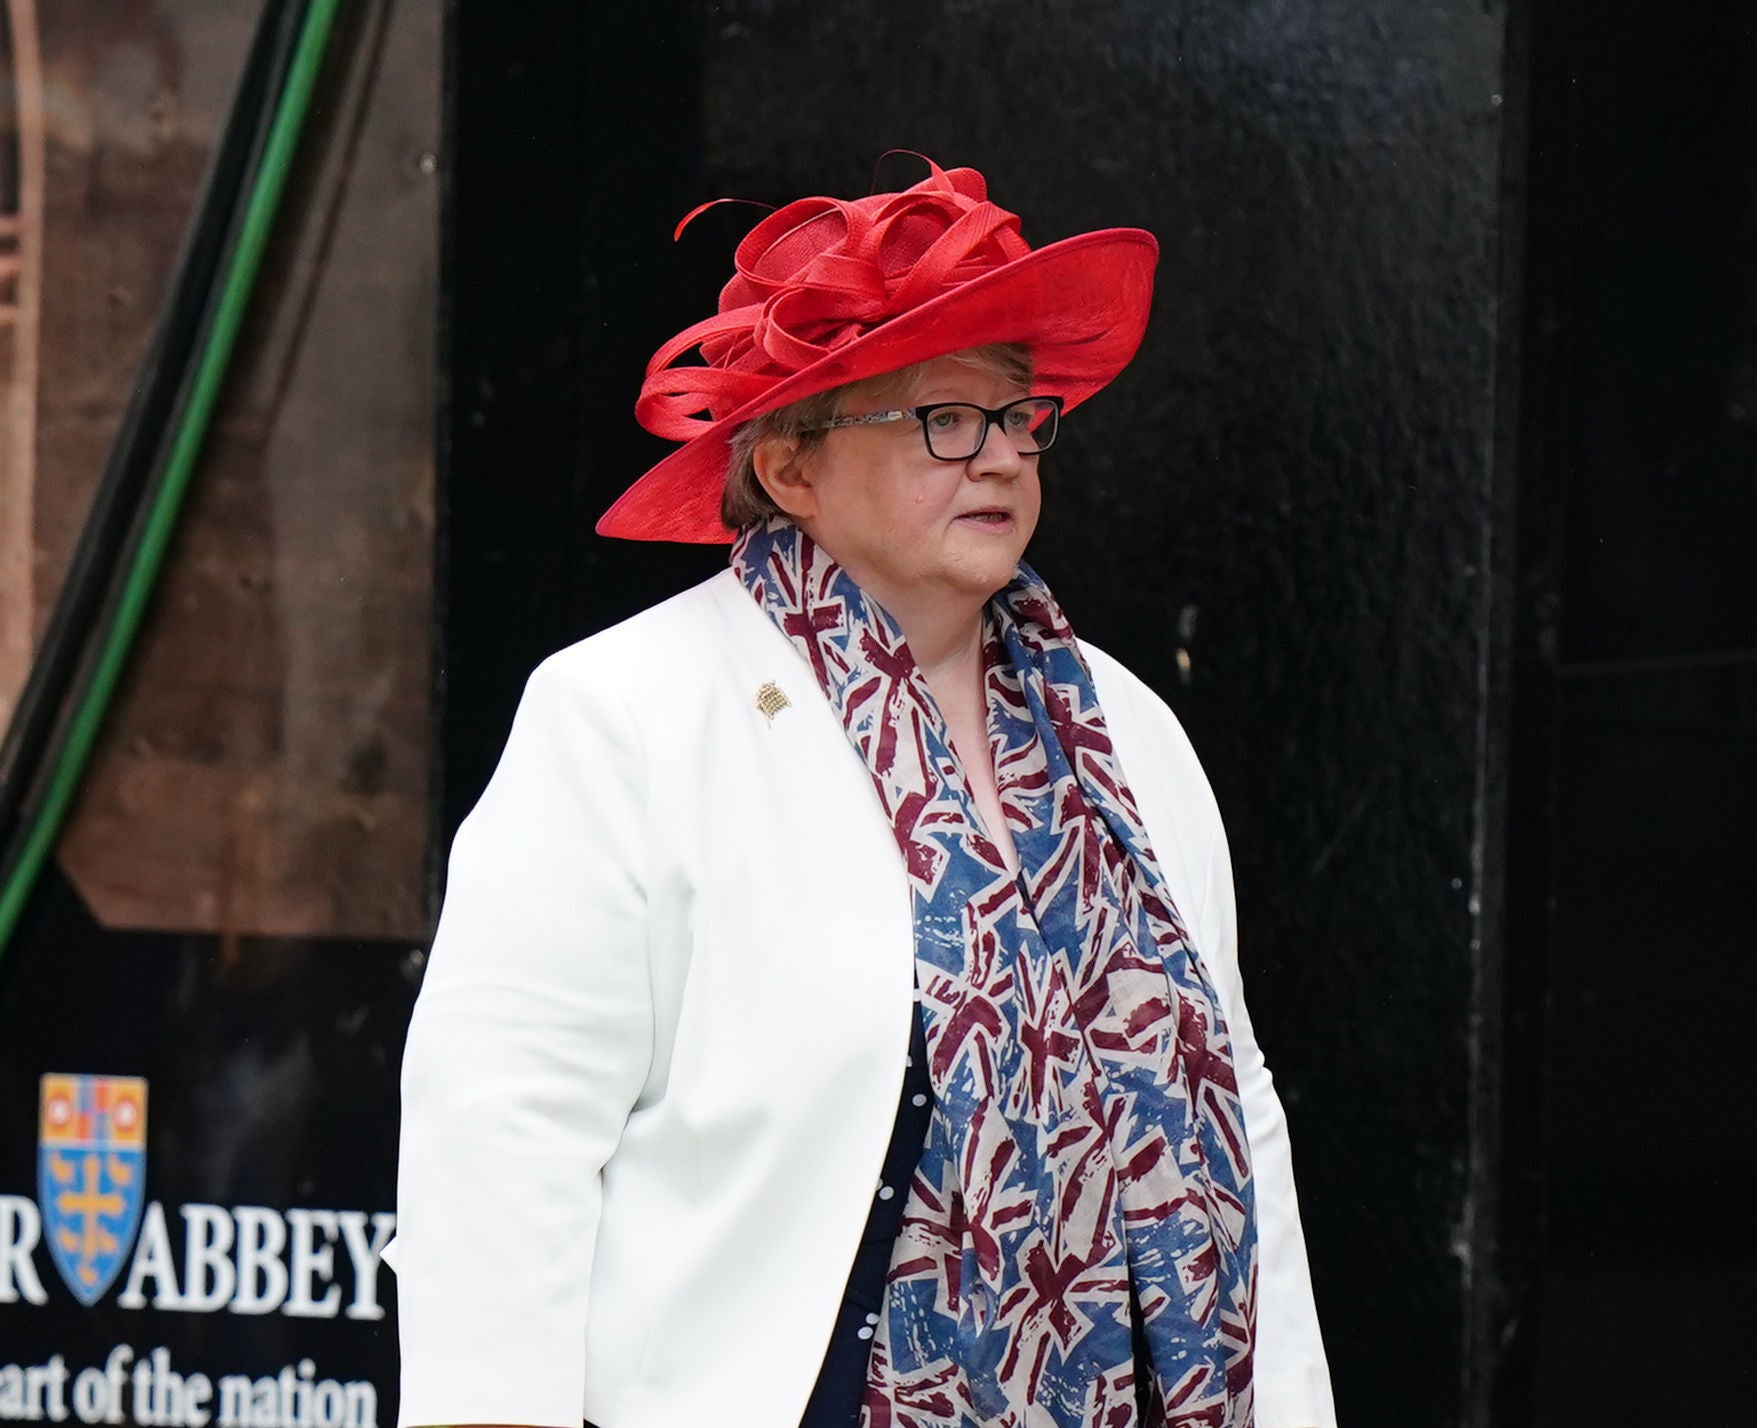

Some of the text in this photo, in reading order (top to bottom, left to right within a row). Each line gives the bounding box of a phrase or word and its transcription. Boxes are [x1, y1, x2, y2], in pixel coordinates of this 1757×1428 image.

[118, 1200, 394, 1320] ABBEY
[74, 1343, 133, 1424] of
[133, 1346, 212, 1427] the
